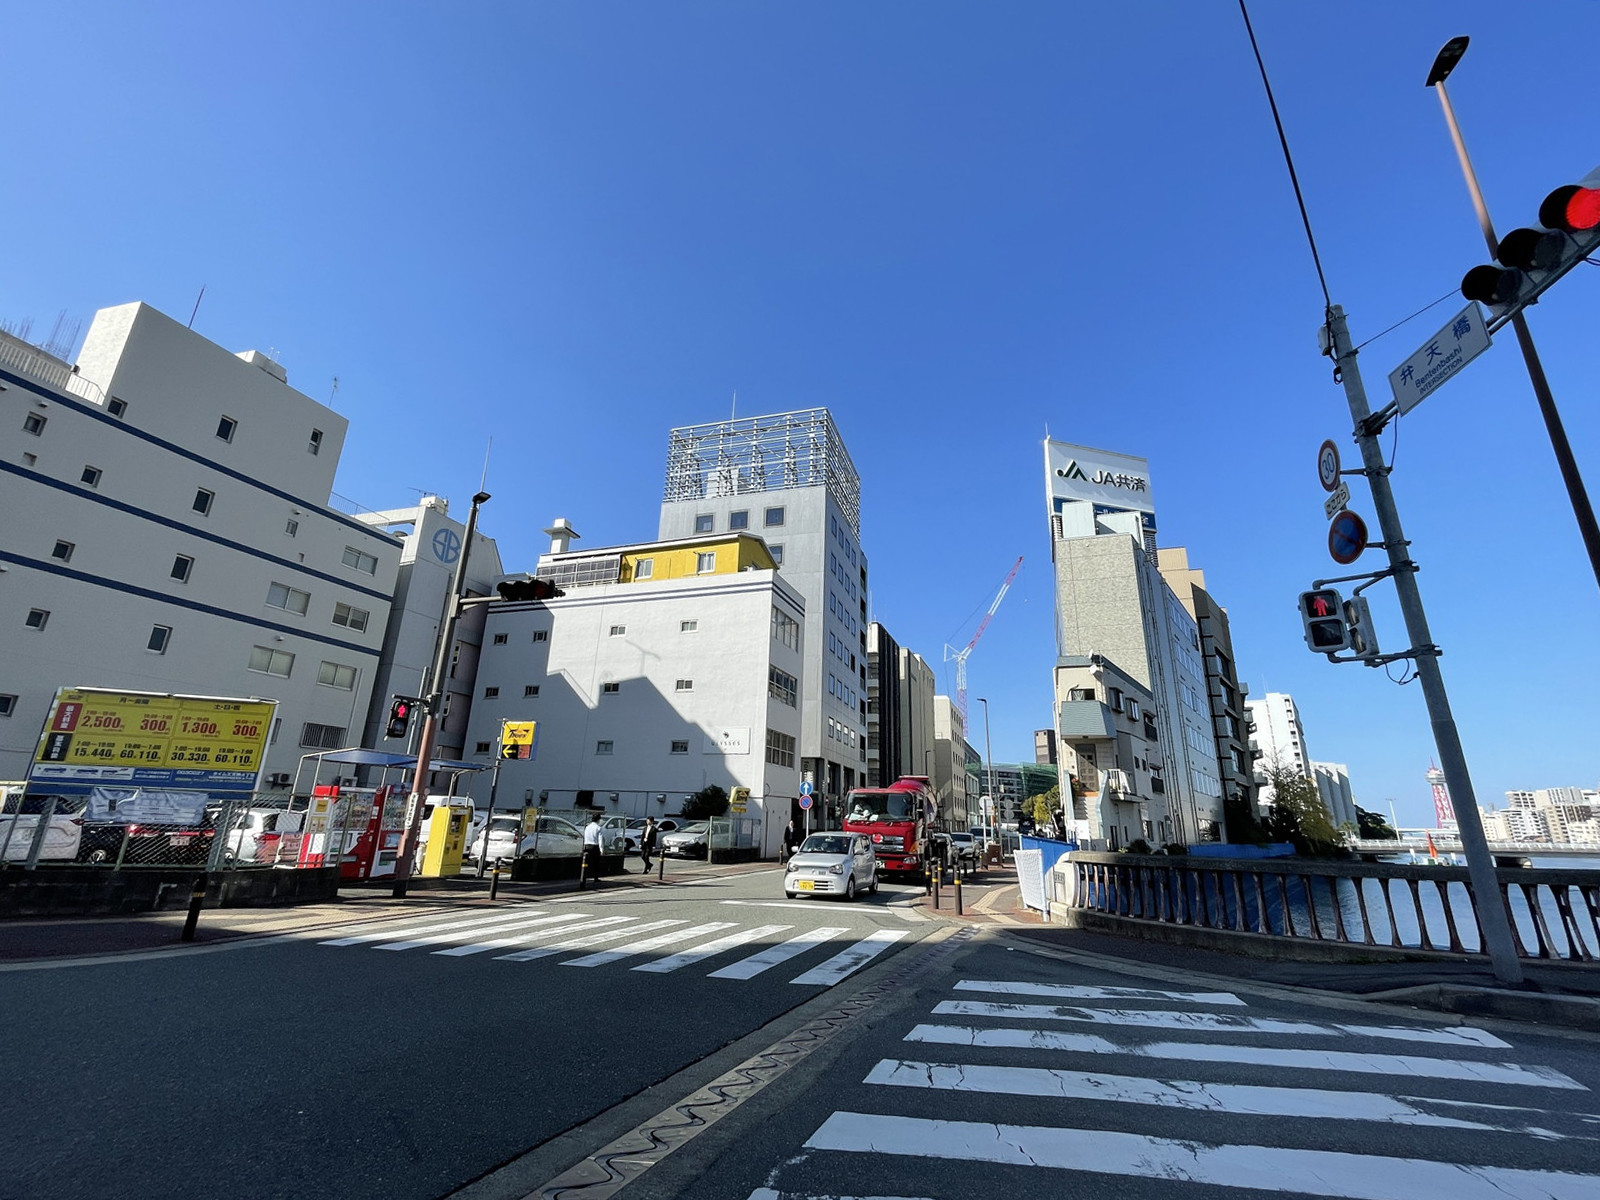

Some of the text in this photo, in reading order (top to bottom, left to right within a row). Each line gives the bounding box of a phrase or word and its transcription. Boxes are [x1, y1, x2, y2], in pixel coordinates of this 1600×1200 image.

[1414, 346, 1463, 388] Bentenbashi
[1418, 356, 1463, 394] INTERSECTION
[1321, 452, 1334, 480] 30
[1091, 470, 1146, 492] JA共済
[1326, 488, 1347, 514] ここから
